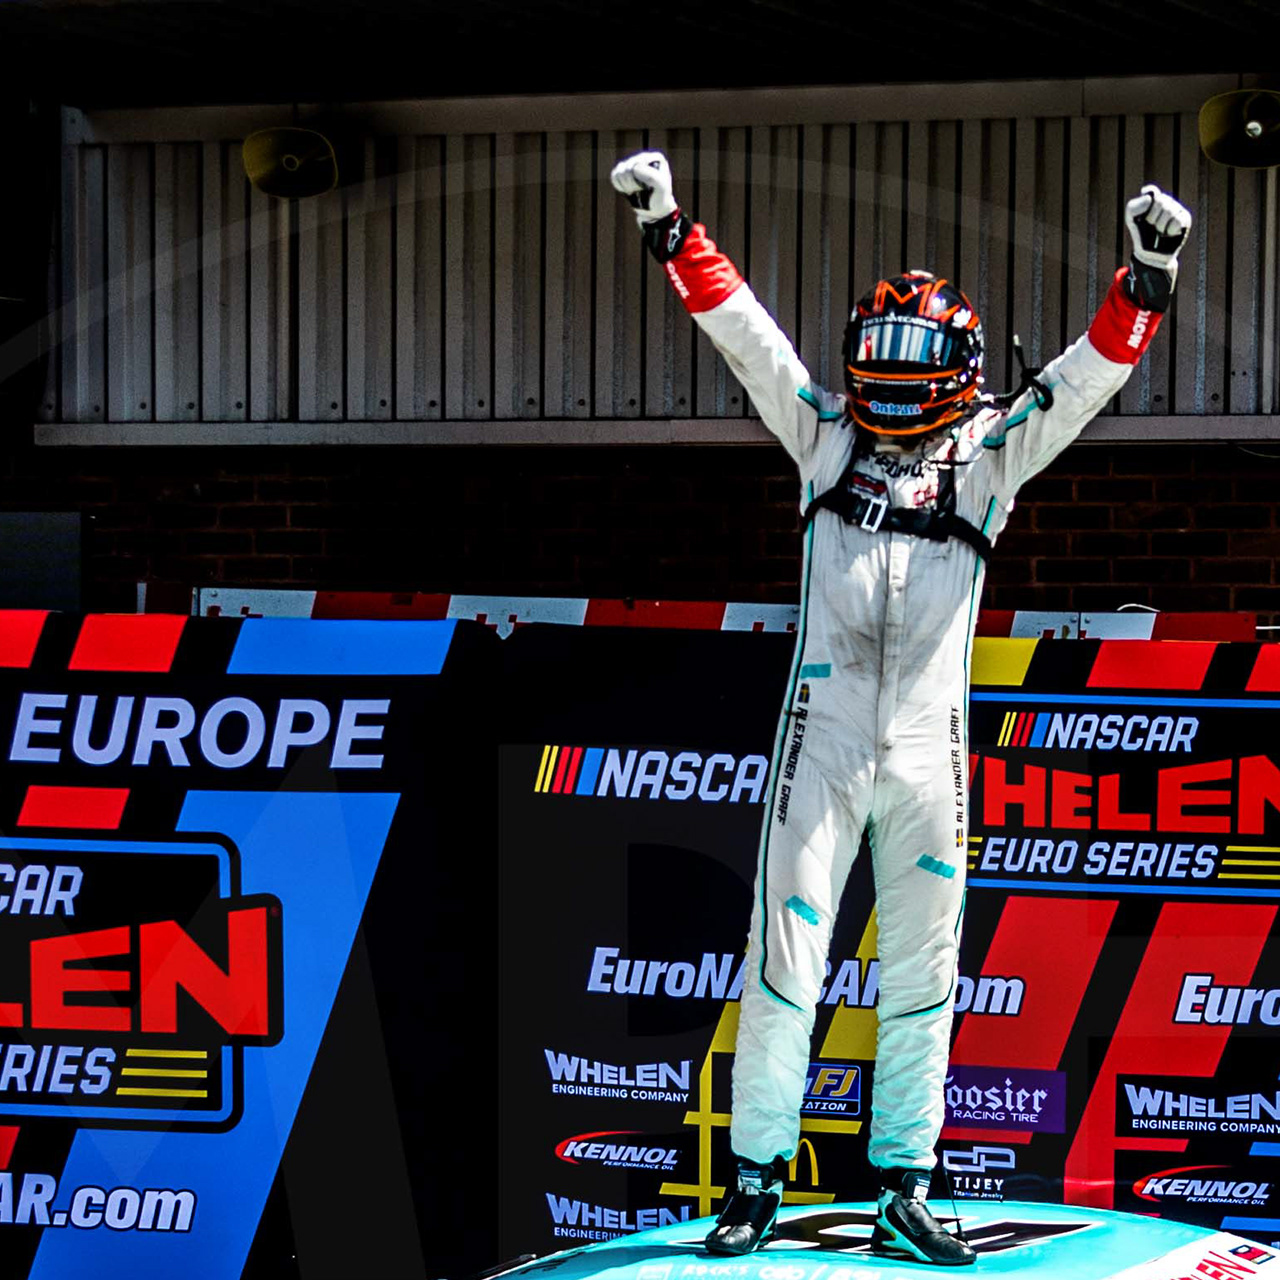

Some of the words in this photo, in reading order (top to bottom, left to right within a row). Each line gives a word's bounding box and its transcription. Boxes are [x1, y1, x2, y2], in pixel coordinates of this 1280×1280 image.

[8, 691, 391, 769] EUROPE
[783, 706, 809, 781] ALEXANDER
[1048, 712, 1199, 754] NASCAR
[597, 748, 767, 803] NASCA
[776, 785, 792, 826] GRAFF
[980, 837, 1078, 875] EURO
[1083, 842, 1218, 880] SERIES
[545, 1049, 690, 1090] WHELEN
[552, 1084, 629, 1099] ENGINEERING
[630, 1089, 690, 1103] COMPANY
[945, 1078, 1048, 1114] oosier
[953, 1109, 1006, 1122] RACING
[1011, 1112, 1039, 1124] TIRE
[1132, 1118, 1217, 1133] ENGINEERING
[564, 1142, 680, 1166] KENNOL
[954, 1176, 1005, 1191] TIJEY
[1142, 1177, 1270, 1200] KENNOL
[547, 1193, 690, 1231] WHELEN
[554, 1227, 626, 1241] ENGINEERIN
